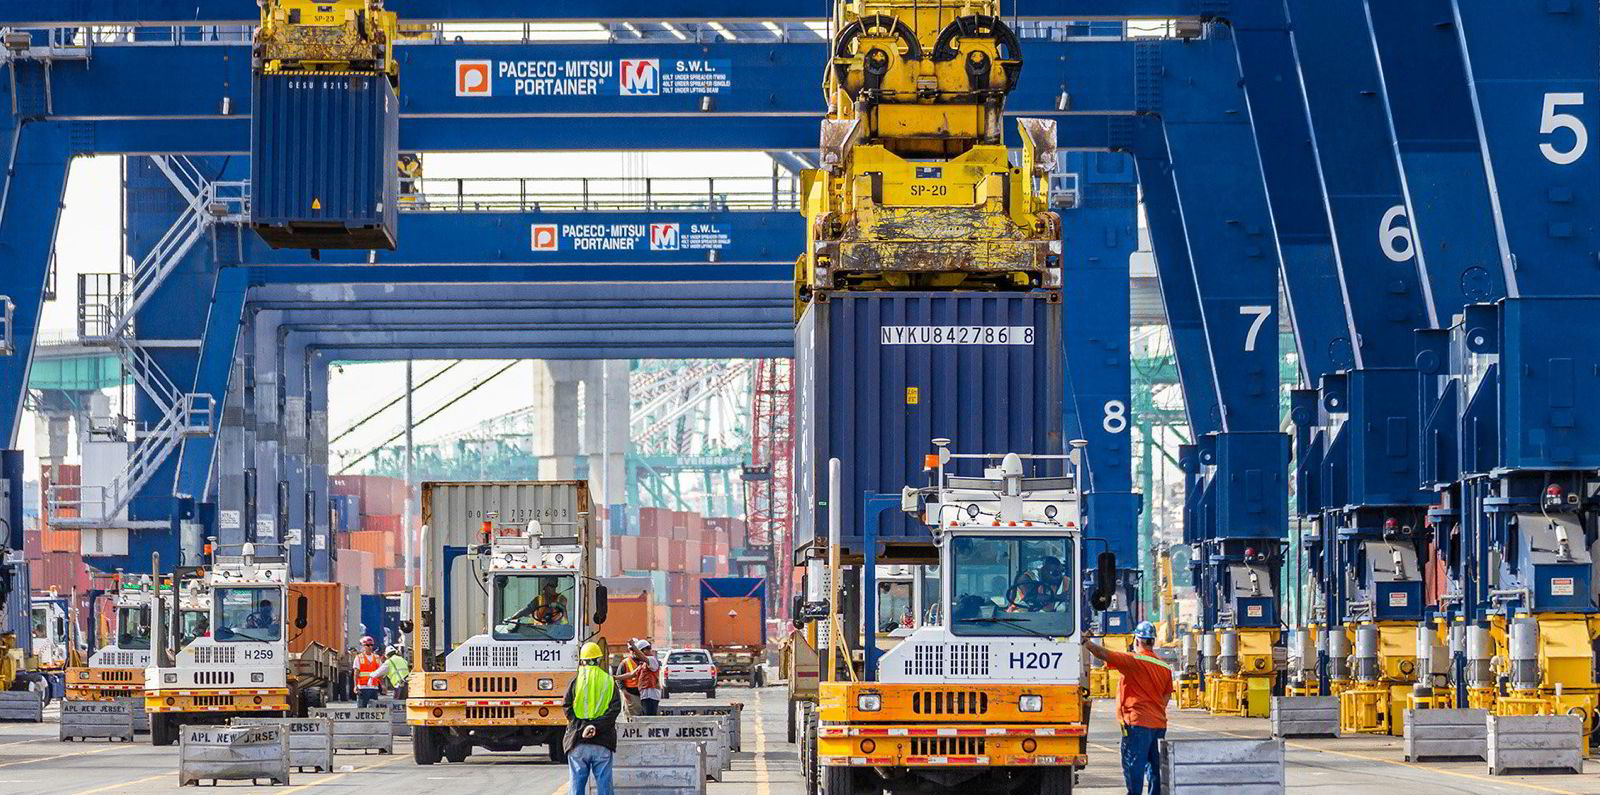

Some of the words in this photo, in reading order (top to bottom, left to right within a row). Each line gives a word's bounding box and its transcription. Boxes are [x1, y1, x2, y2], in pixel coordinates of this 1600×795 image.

[499, 61, 612, 77] PACECO-MITSUI
[1539, 92, 1588, 165] 5
[911, 185, 947, 196] SP-20
[562, 224, 645, 237] PACECO-MITSUI
[1378, 205, 1415, 262] 6
[1239, 305, 1271, 352] 7
[1103, 400, 1126, 433] 8
[534, 650, 561, 661] H211
[1009, 652, 1063, 669] H207
[334, 711, 351, 719] NEW
[356, 711, 386, 720] JERSEY
[290, 723, 320, 732] ERSEY
[622, 729, 642, 738] APL
[648, 728, 669, 738] NEW
[676, 727, 714, 737] JERSEY
[191, 732, 211, 742] APL
